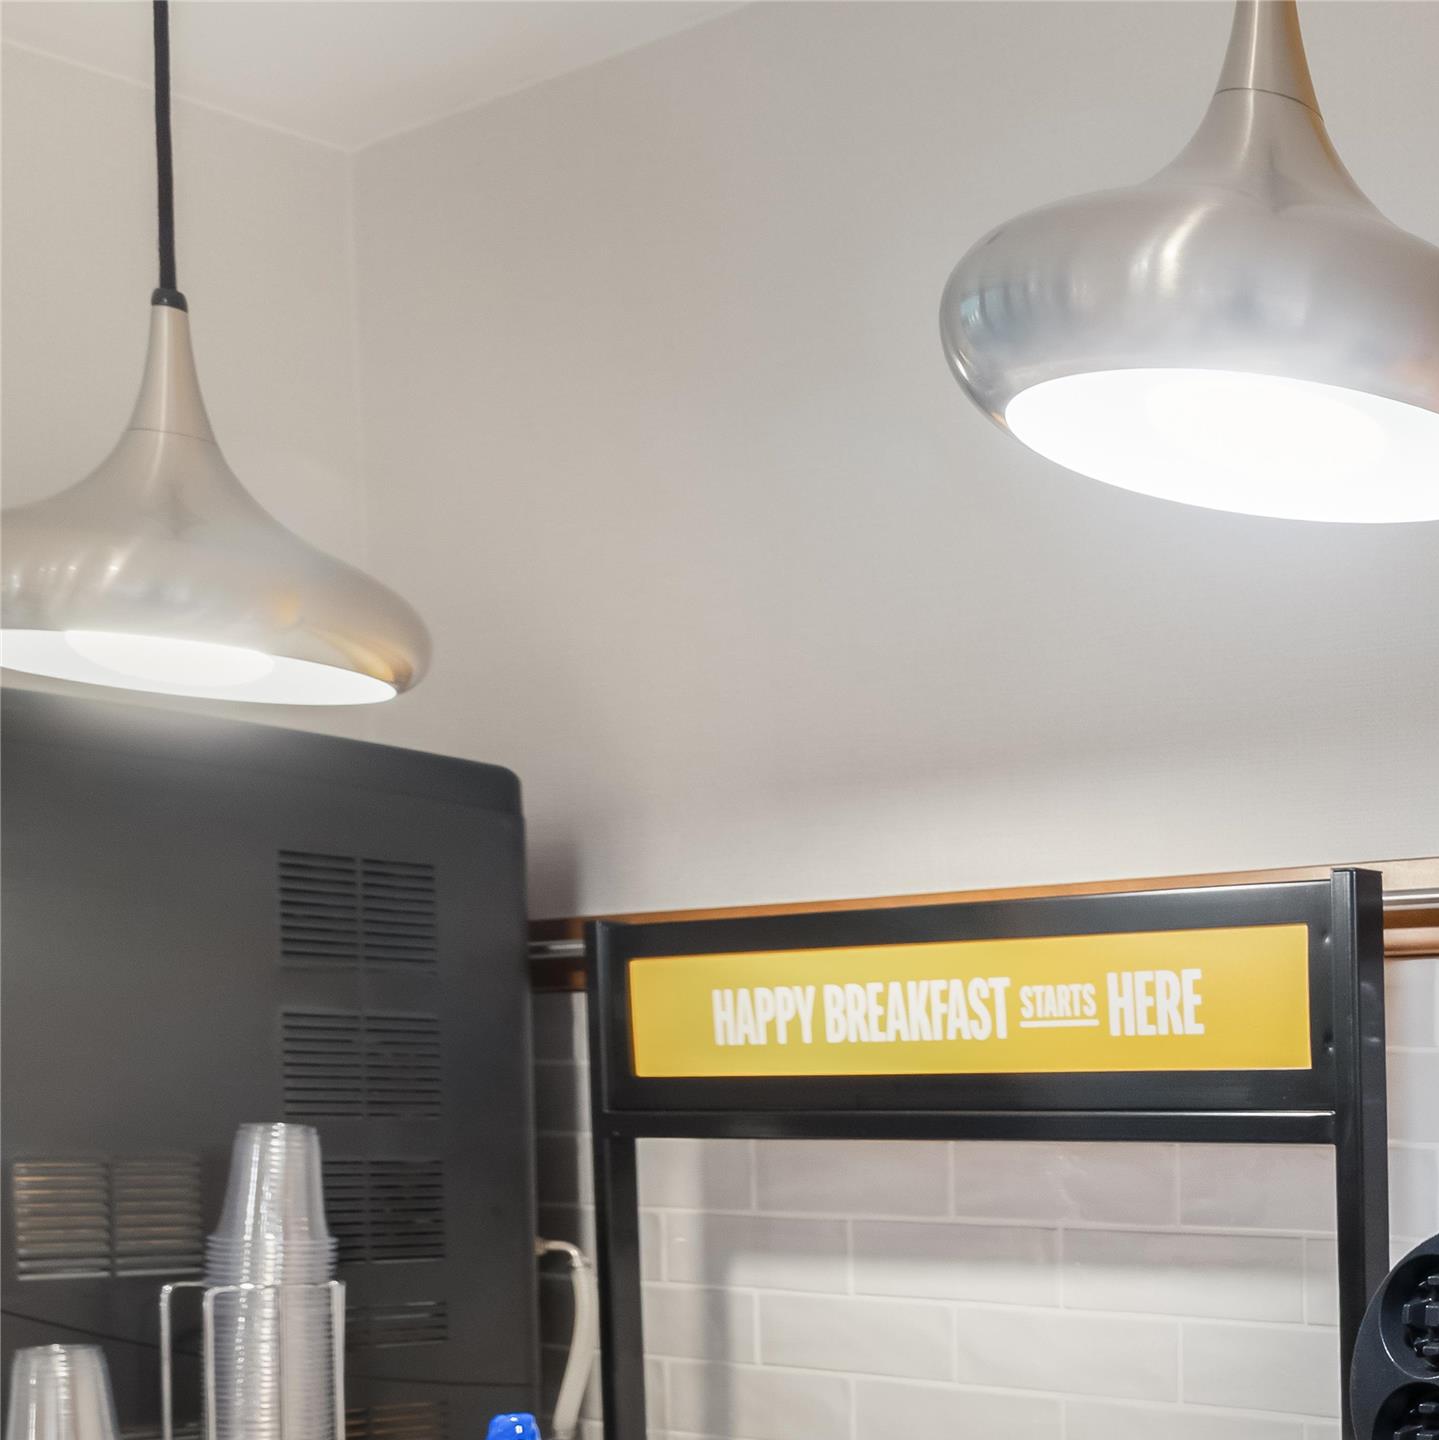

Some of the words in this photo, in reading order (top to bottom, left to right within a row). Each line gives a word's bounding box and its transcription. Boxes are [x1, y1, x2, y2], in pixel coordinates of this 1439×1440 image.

[711, 985, 816, 1046] HAPPY
[823, 976, 1011, 1043] BREAKFAST
[1019, 983, 1098, 1019] STARTS
[1106, 967, 1205, 1036] HERE
